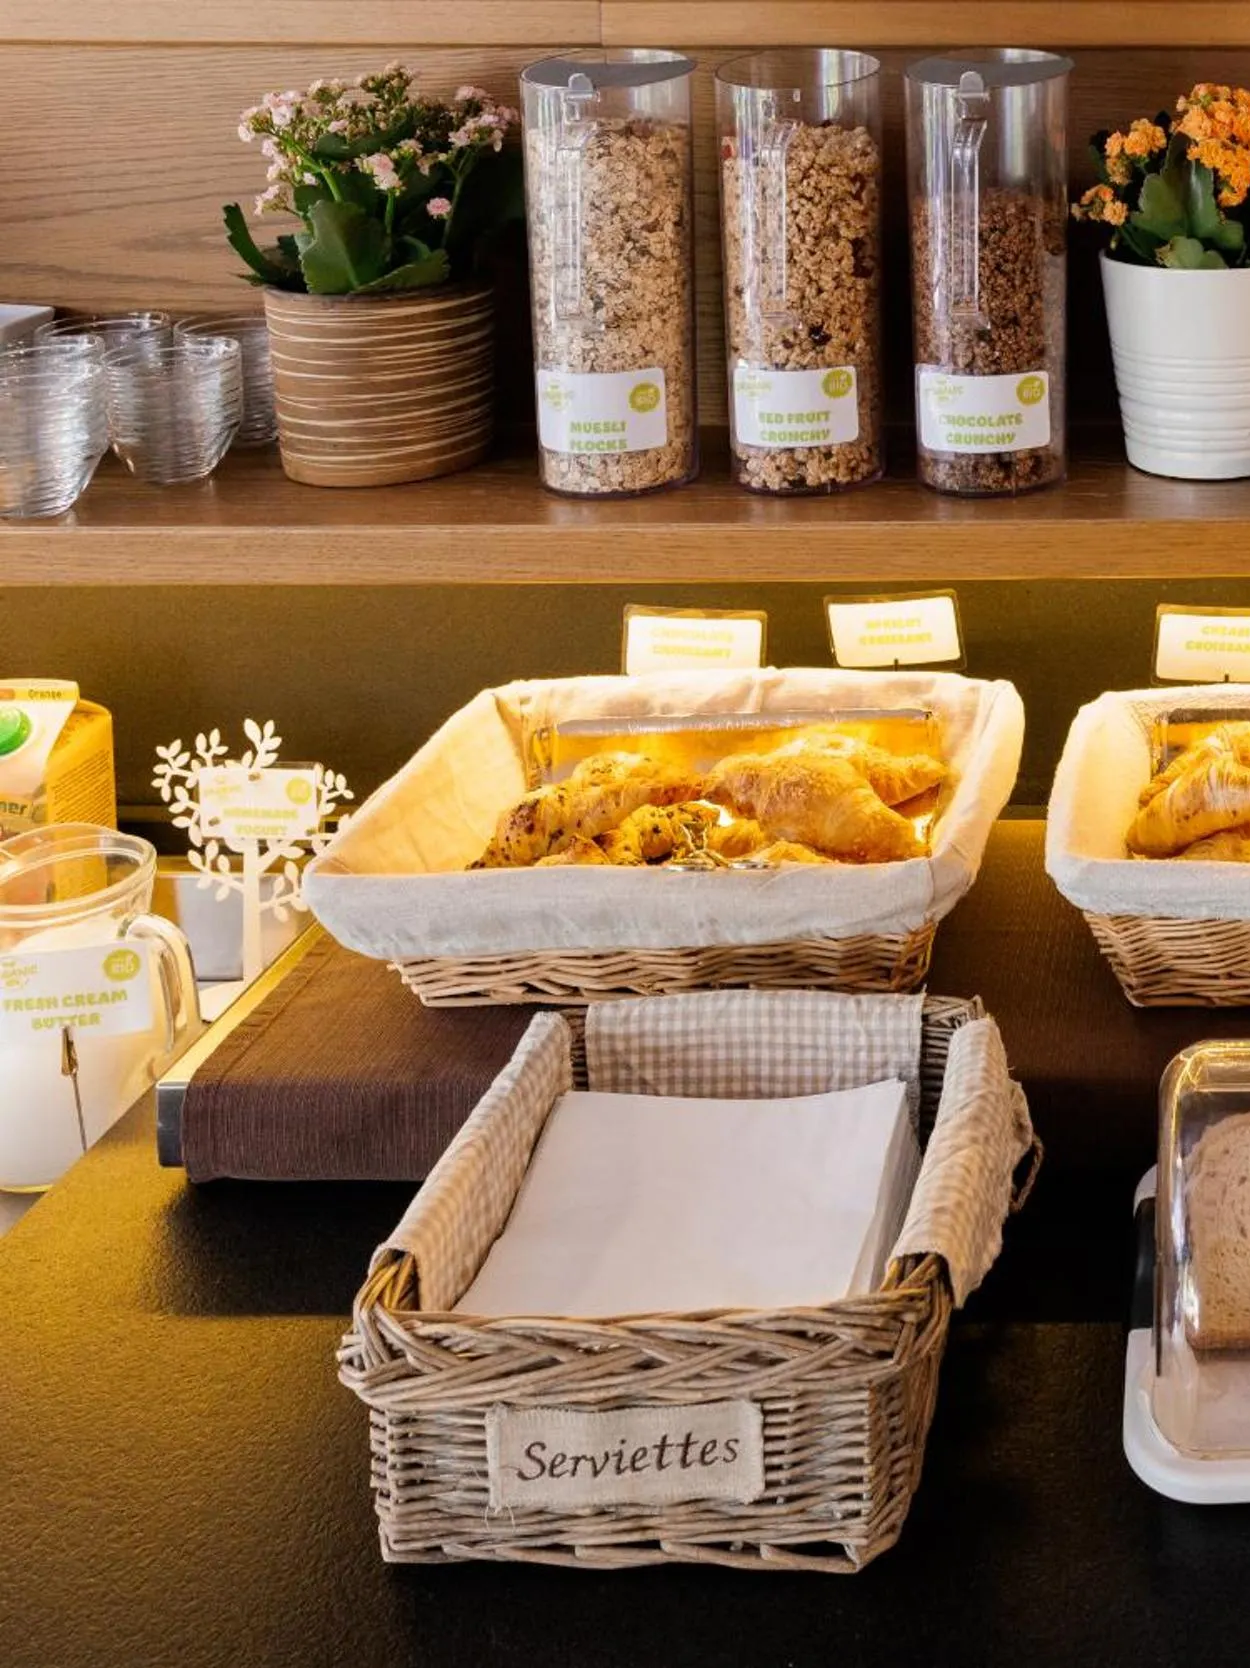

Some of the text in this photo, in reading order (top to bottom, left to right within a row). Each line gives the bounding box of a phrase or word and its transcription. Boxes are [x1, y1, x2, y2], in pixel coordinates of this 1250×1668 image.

[758, 410, 831, 424] RED FRUIT
[938, 412, 1023, 428] CHOCOLATE
[570, 420, 628, 434] MUESLI
[760, 429, 831, 443] CRUNCHY
[946, 431, 1016, 445] CRUNCHY
[28, 688, 63, 700] Orange
[61, 989, 128, 1008] CREAM
[31, 1012, 102, 1031] BUTTER
[516, 1431, 740, 1481] Serviettes
